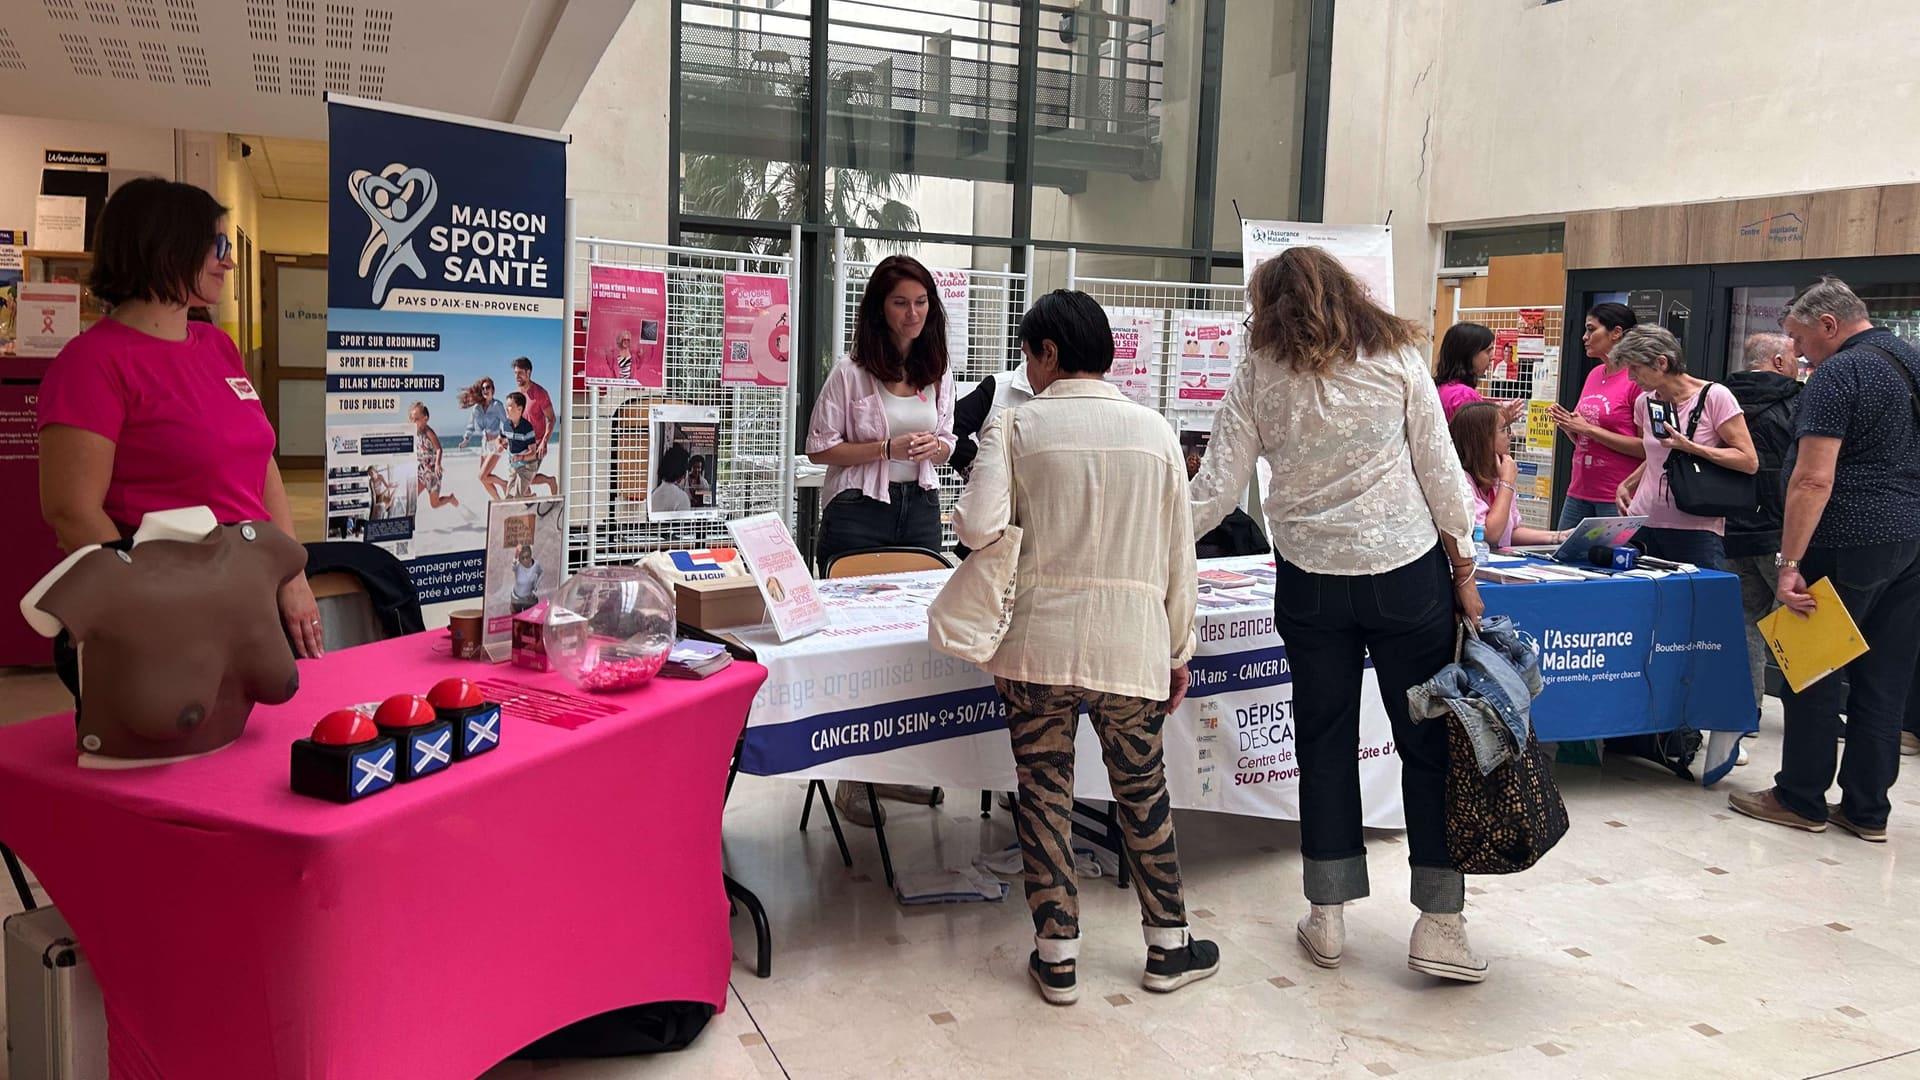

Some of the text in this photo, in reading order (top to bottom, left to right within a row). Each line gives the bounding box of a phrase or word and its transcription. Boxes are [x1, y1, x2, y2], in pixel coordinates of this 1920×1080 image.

[451, 204, 546, 234] MAISON
[429, 226, 536, 260] SPORT
[443, 256, 548, 289] SANTÉ
[944, 288, 966, 298] Rose
[398, 296, 540, 313] PAYS D'AIX-EN-PROVENCE
[340, 334, 436, 349] SPORT SUR ORDONNANCE
[1122, 340, 1139, 348] SEIN
[339, 356, 408, 368] SPORT BIEN-ÊTRE
[339, 375, 440, 389] BILANS MÉDICO-SPORTIFS
[339, 398, 395, 411] TOUS PUBLICS
[463, 558, 482, 568] vers
[416, 573, 452, 586] activité
[443, 586, 450, 595] à
[452, 584, 476, 595] votre
[1200, 615, 1226, 643] des
[1543, 629, 1633, 649] l'Assurance
[1542, 649, 1605, 671] Maladie
[824, 661, 913, 703] organisé
[922, 653, 956, 680] des
[1208, 670, 1228, 684] ans
[1239, 659, 1278, 680] CANCER
[1556, 672, 1591, 682] ensemble,
[1592, 671, 1620, 682] protéger
[1620, 670, 1641, 679] chacun
[1235, 701, 1294, 729] DÉPIST
[811, 723, 869, 752] CANCER
[873, 719, 893, 741] DU
[955, 701, 997, 725] 50/74
[1237, 748, 1292, 769] Centre de
[1234, 770, 1265, 786] SUD
